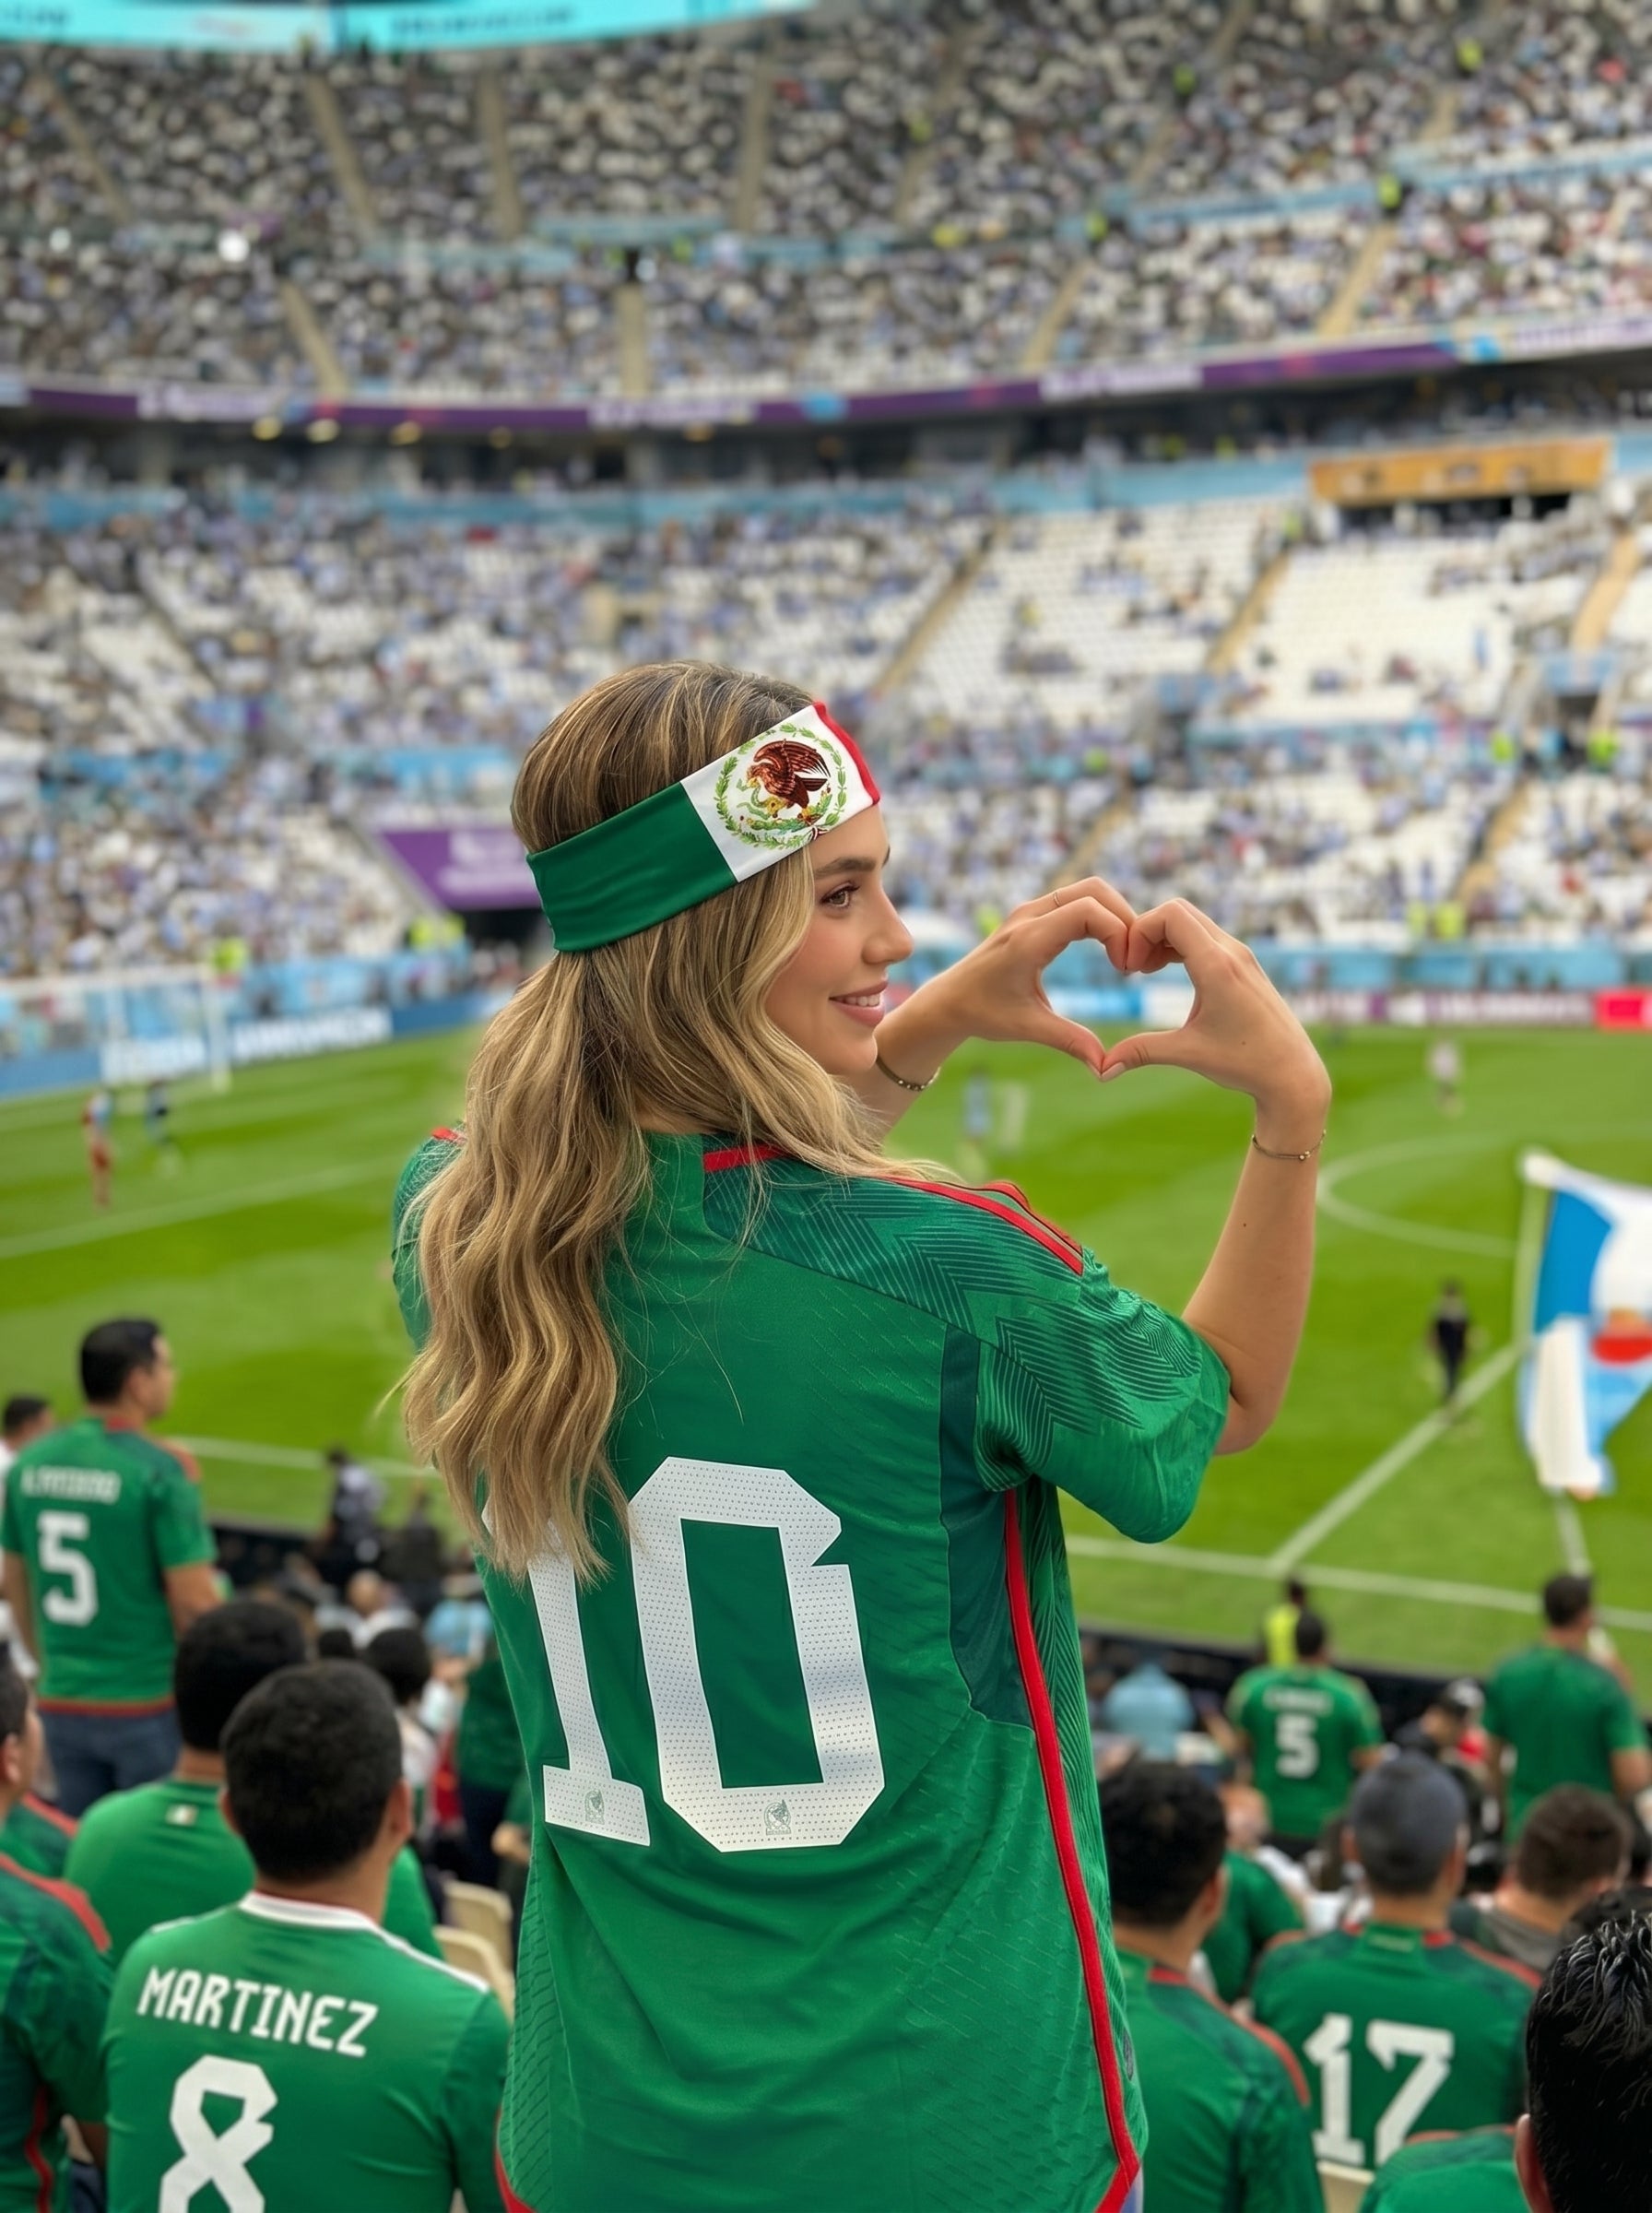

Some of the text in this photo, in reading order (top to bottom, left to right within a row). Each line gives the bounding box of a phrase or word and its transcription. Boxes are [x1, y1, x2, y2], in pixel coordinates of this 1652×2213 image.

[37, 1509, 98, 1627] 5
[481, 1457, 885, 1852] 10
[1276, 1714, 1319, 1779] 5
[136, 1965, 379, 2057] MARTINEZ
[159, 2054, 277, 2213] 8
[1304, 2013, 1455, 2167] 17
